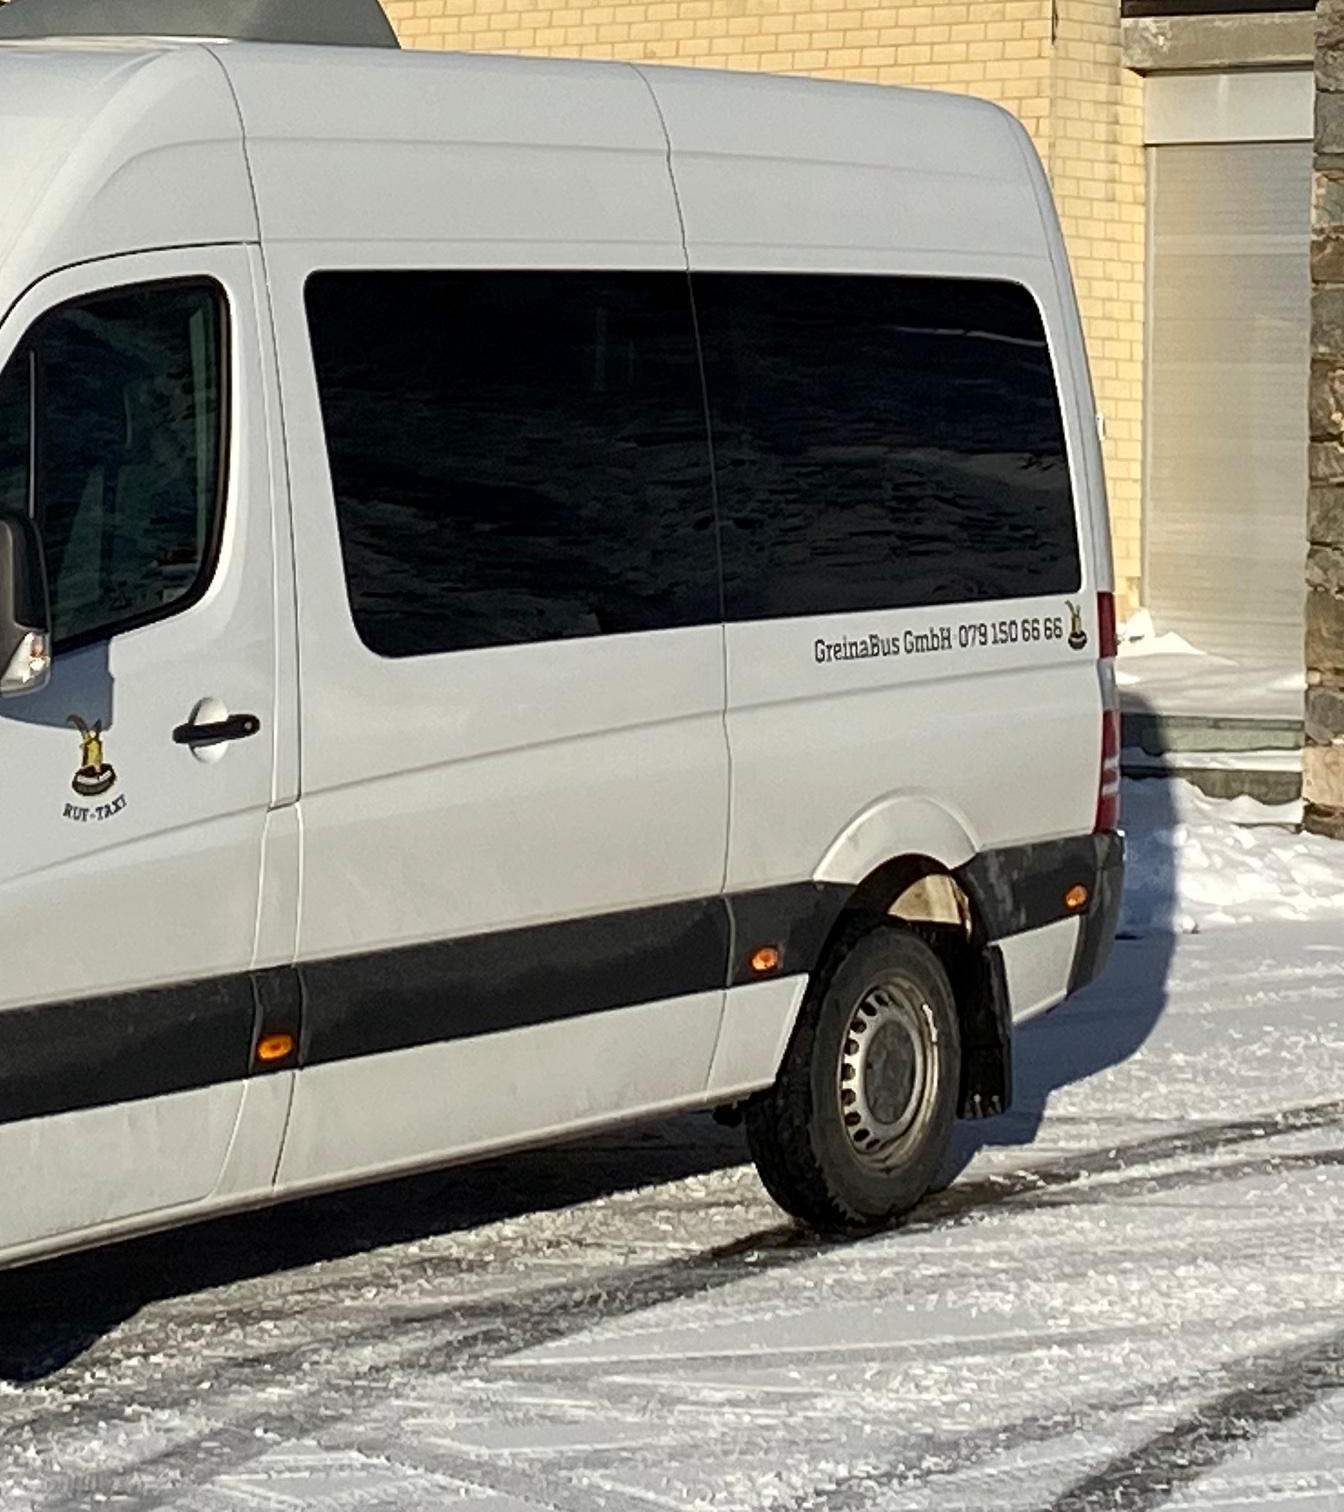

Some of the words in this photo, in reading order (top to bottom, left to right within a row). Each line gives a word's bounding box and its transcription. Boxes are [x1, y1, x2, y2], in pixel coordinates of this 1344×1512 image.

[814, 634, 900, 663] GreinaBus
[903, 627, 953, 654] GmbH
[958, 624, 988, 648] 079
[991, 620, 1018, 644] 150
[1022, 618, 1041, 641] 66
[1044, 617, 1063, 639] 66
